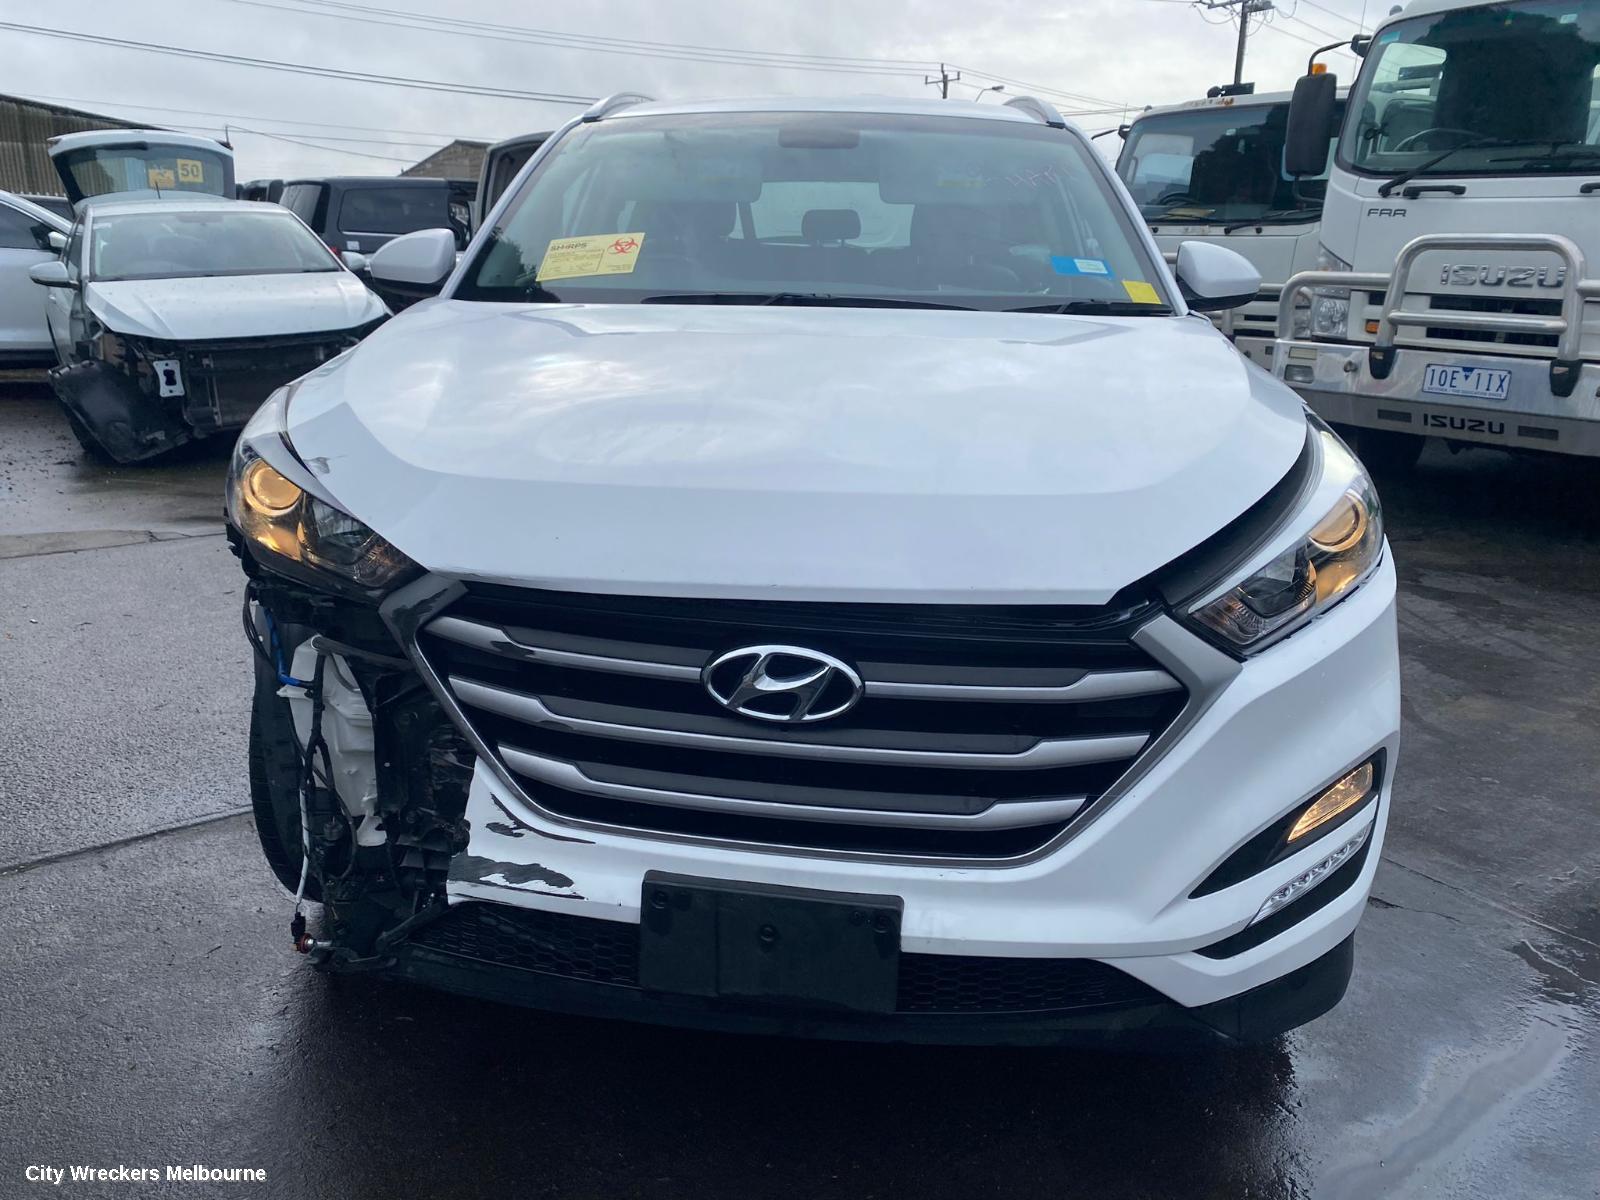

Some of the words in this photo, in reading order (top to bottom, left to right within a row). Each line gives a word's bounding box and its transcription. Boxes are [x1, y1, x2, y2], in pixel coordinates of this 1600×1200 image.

[180, 163, 200, 177] 50
[1367, 208, 1407, 217] FRR
[1440, 263, 1567, 288] ISUZU
[1423, 413, 1505, 435] ISUZU
